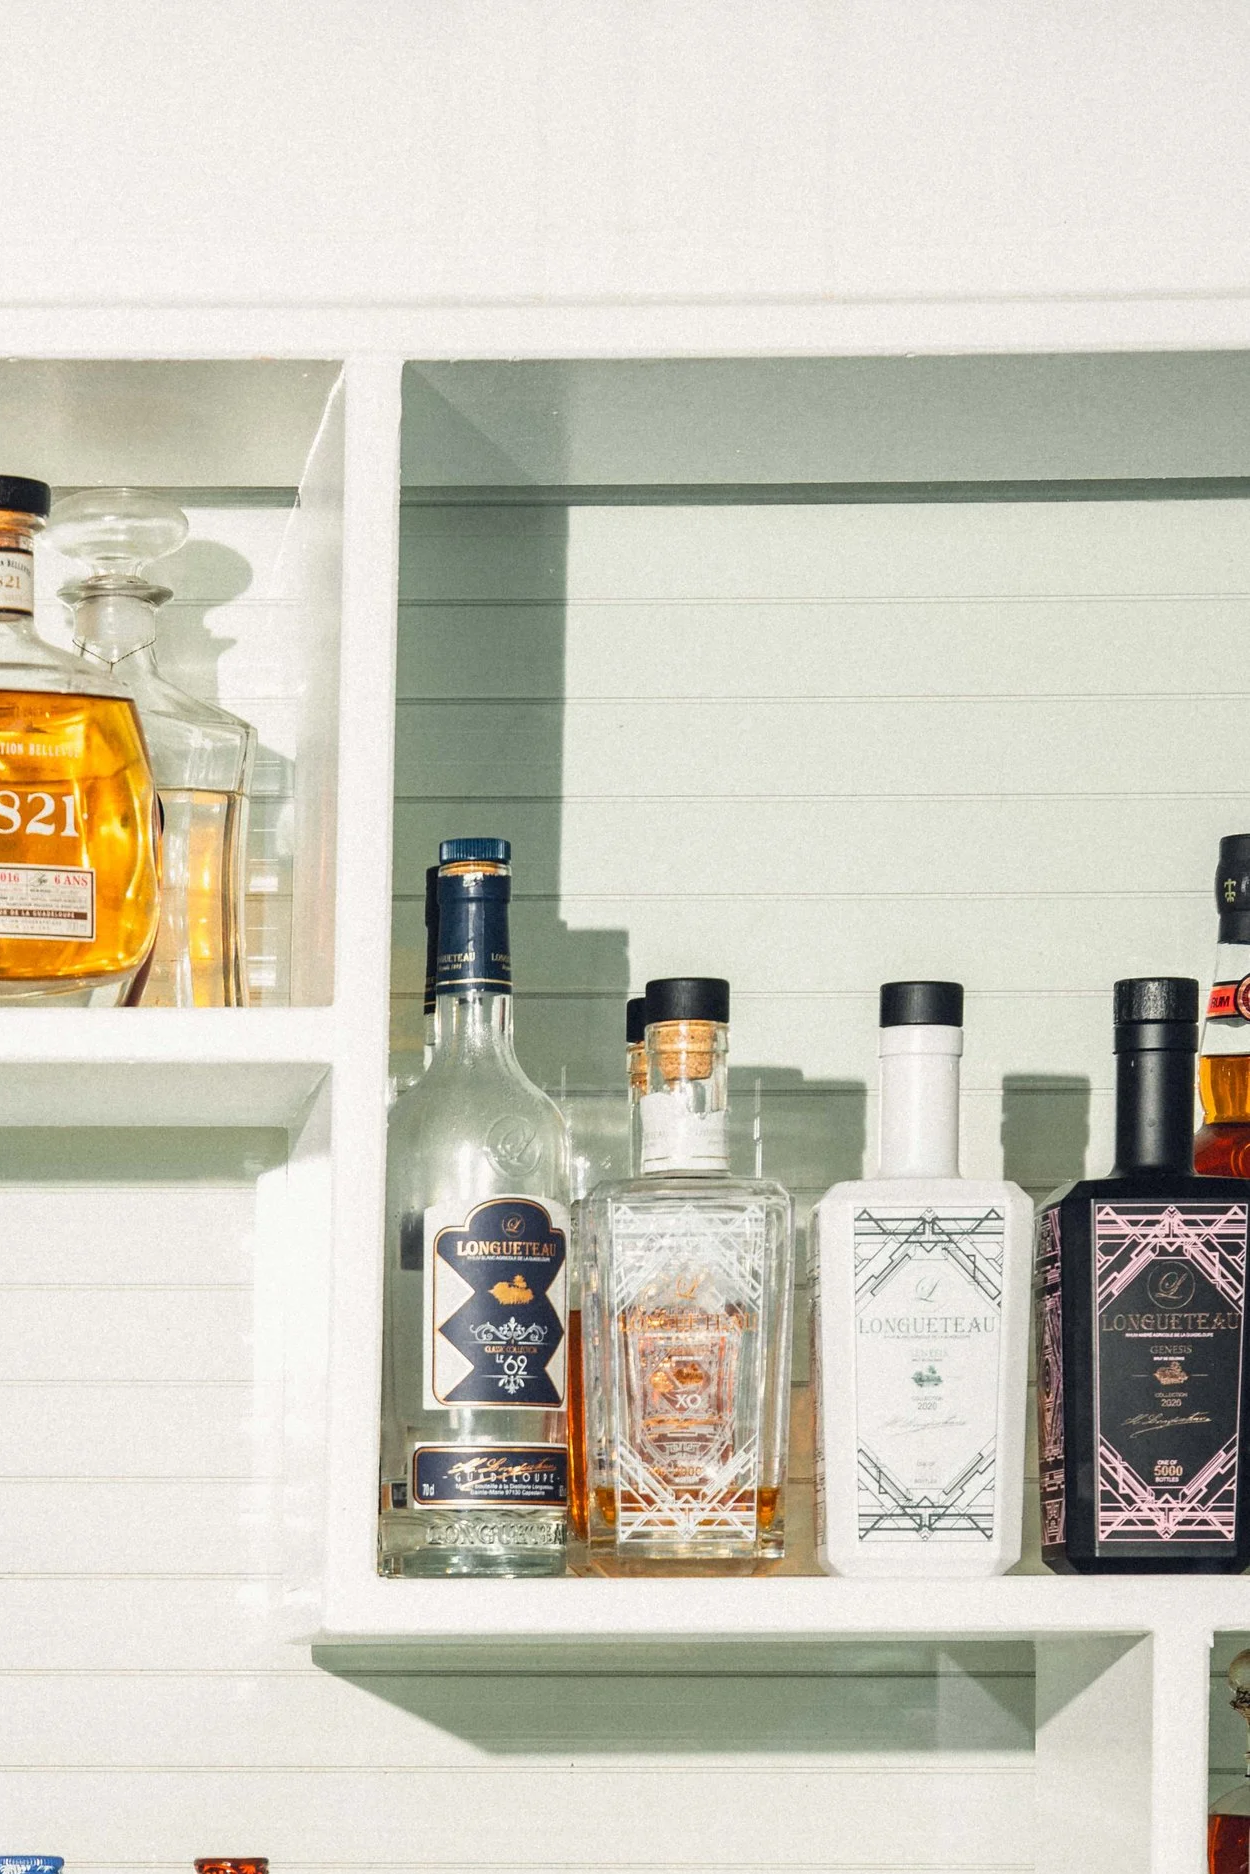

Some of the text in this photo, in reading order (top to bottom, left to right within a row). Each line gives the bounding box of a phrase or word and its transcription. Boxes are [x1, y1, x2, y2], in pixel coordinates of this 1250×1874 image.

[54, 875, 88, 887] 6 ANS
[456, 1240, 556, 1257] LONGUETEAU
[859, 1317, 996, 1334] LONGUETEAU
[1102, 1313, 1239, 1331] LONGUETEAU
[496, 1355, 528, 1375] LE 62
[675, 1394, 702, 1409] XO
[917, 1402, 937, 1411] 2020
[455, 1473, 555, 1483] GUADELOUPE
[1154, 1466, 1183, 1476] 5000
